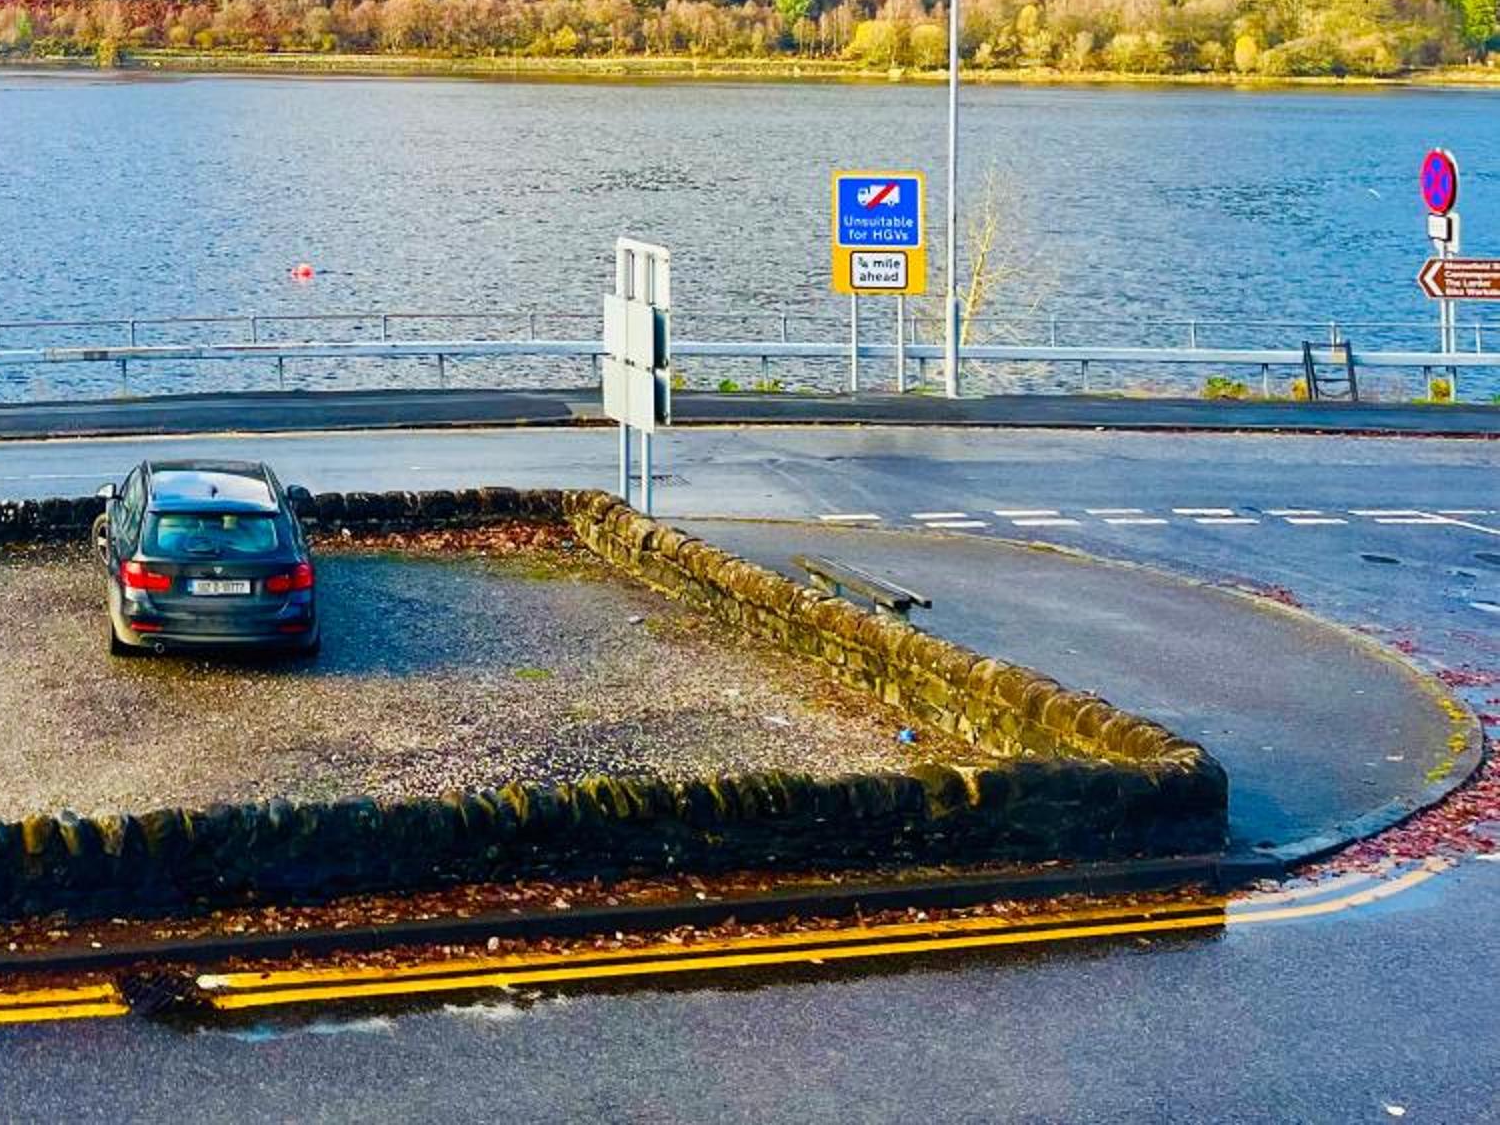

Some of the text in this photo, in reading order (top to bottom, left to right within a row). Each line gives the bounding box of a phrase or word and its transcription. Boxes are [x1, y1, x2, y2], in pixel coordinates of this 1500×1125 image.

[843, 215, 913, 227] Unsuitable
[849, 228, 909, 241] for HGVs
[873, 256, 901, 269] mile
[859, 271, 899, 282] ahead
